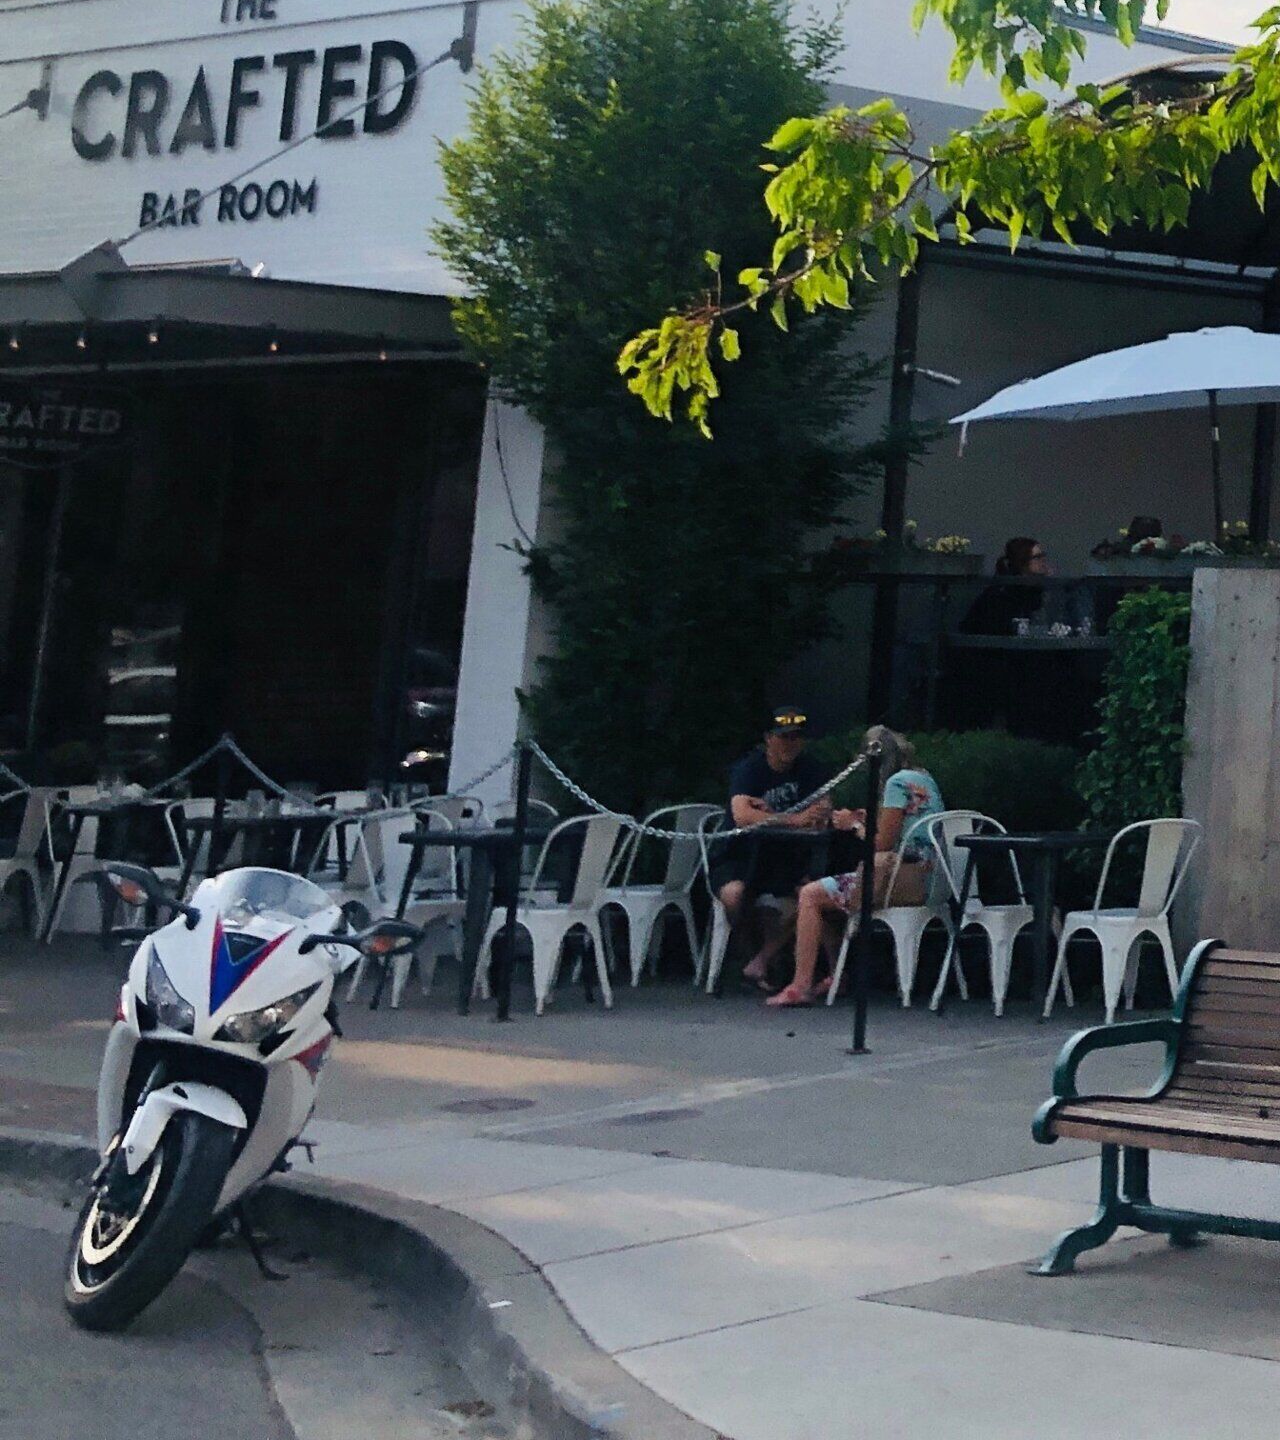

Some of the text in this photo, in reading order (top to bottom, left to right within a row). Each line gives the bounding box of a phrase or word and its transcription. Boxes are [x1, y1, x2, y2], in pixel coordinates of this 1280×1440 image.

[71, 40, 418, 161] CRAFTED
[139, 176, 318, 229] BAR ROOM
[0, 401, 122, 435] RAFTED
